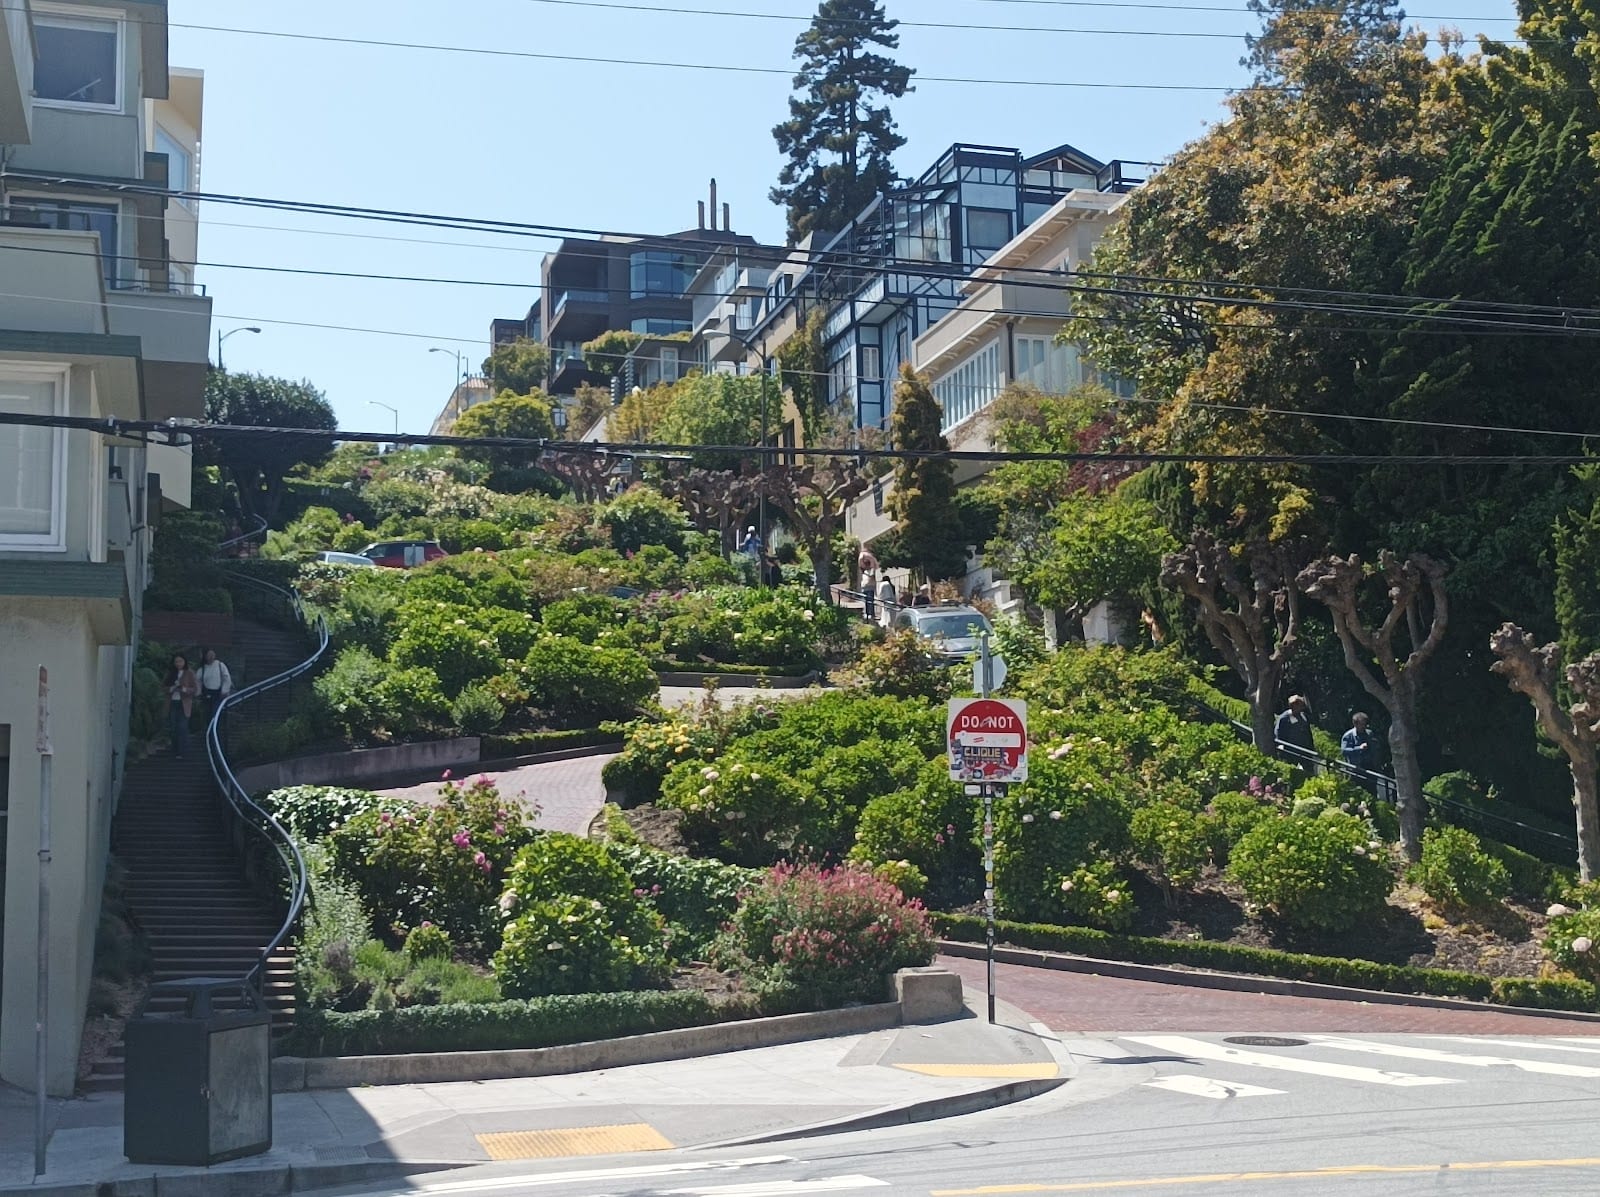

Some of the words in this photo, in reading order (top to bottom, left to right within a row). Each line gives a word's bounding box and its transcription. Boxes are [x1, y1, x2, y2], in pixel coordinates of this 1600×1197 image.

[962, 716, 979, 728] DO
[988, 716, 1014, 728] NOT
[964, 747, 1001, 757] CLIQUE
